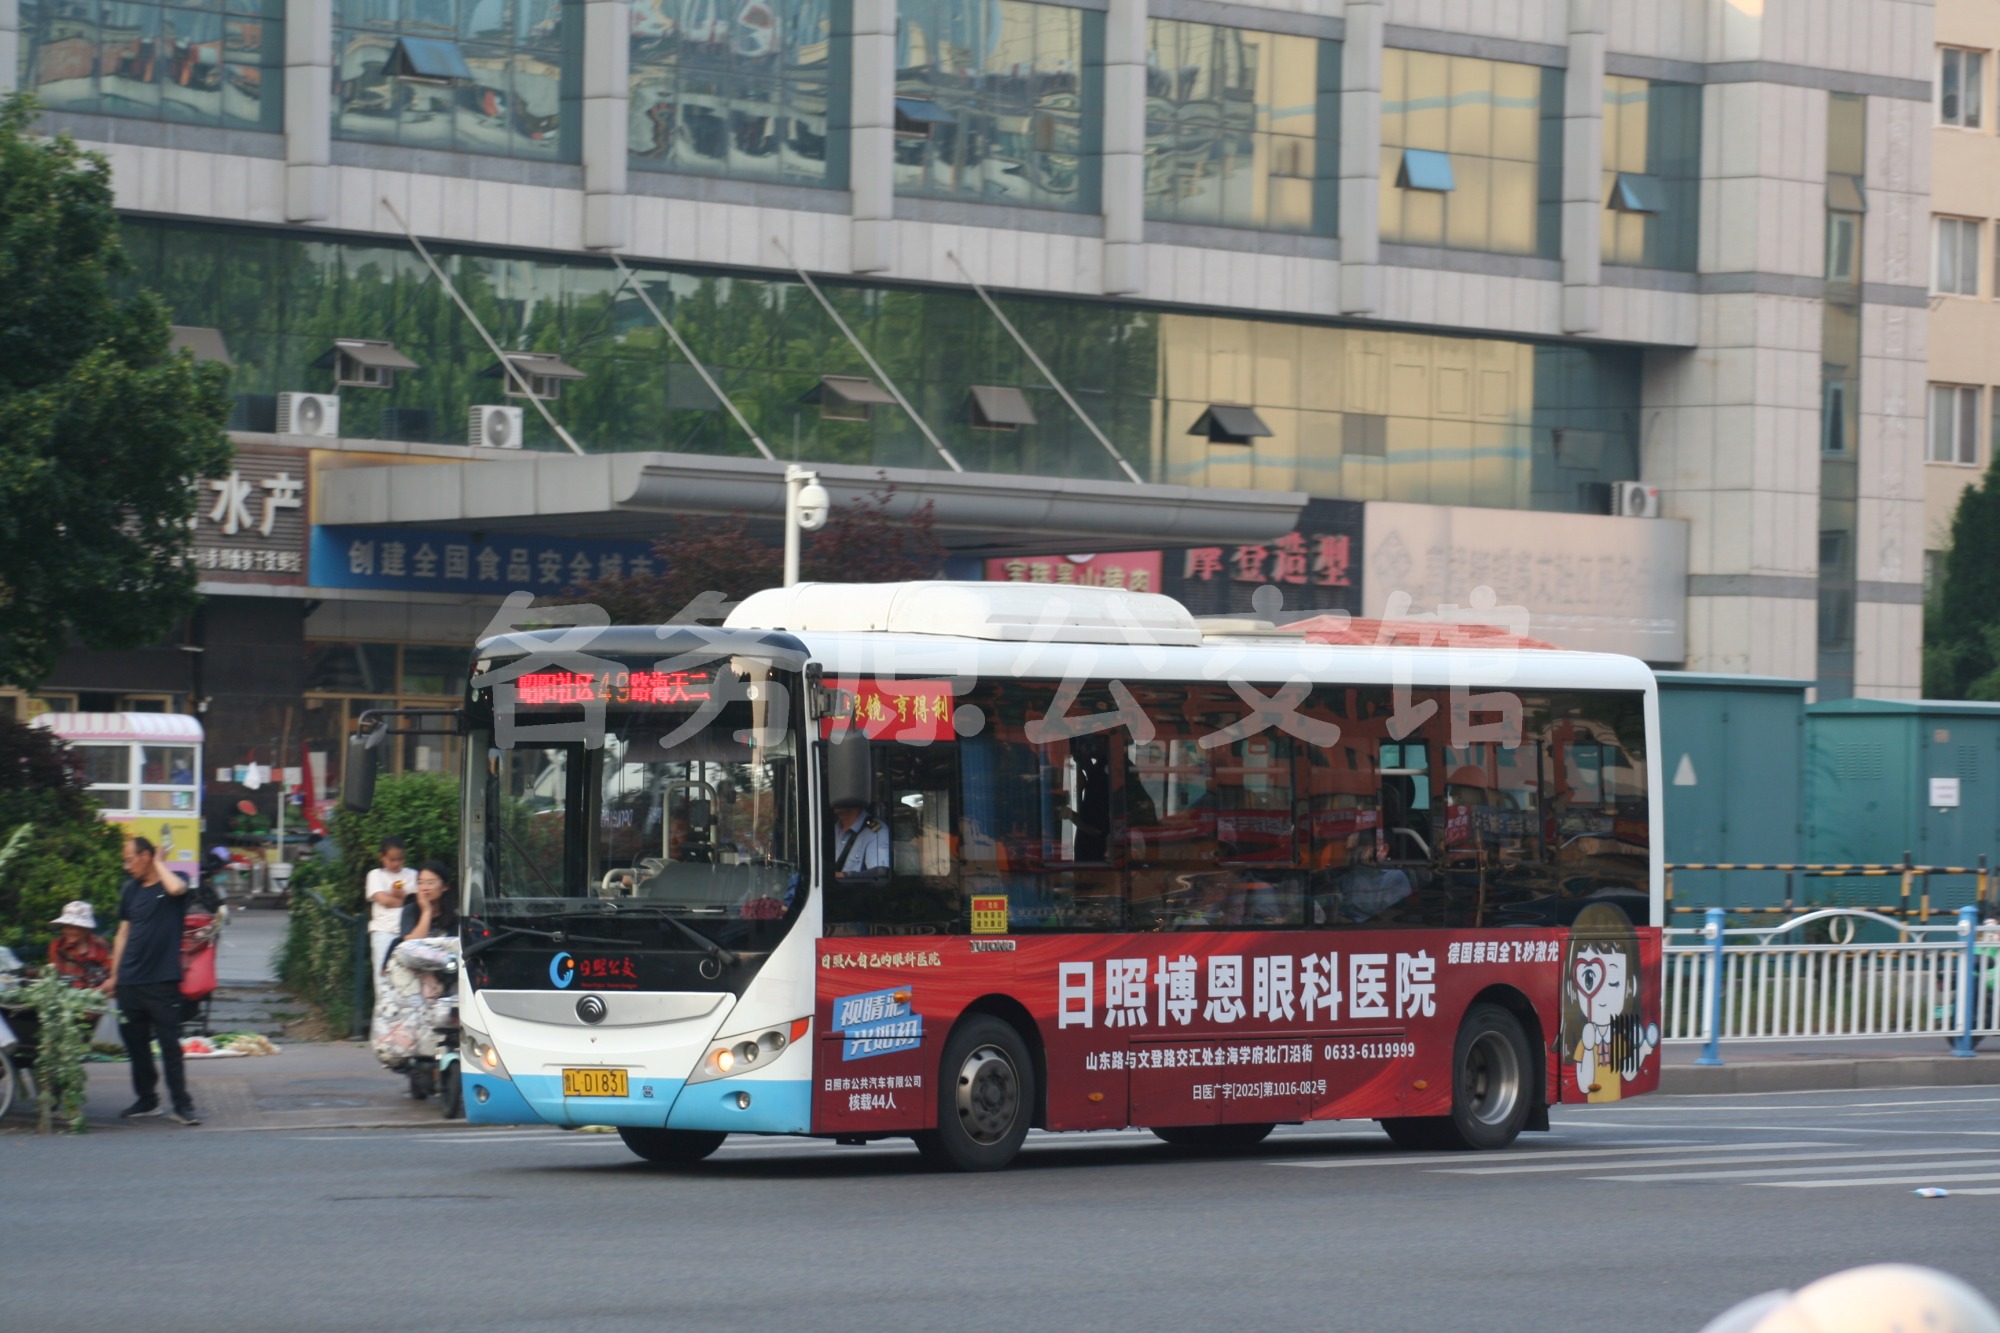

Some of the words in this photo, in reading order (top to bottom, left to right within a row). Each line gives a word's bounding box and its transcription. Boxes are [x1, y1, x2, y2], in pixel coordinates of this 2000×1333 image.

[163, 470, 304, 538] 水产
[892, 694, 950, 723] 亨得利
[970, 940, 1016, 953] YUTONG
[1447, 940, 1560, 965] 德国蔡司全飞秒激光
[821, 951, 942, 969] 日照人自己的眼科医院
[1058, 949, 1437, 1030] 日照博恩眼科医院
[850, 1019, 919, 1056] 光如初
[1085, 1044, 1313, 1071] 山东路与文登路交汇处金海学府北门沿街
[1324, 1042, 1416, 1061] 0633-6119999
[824, 1075, 922, 1092] 日照市公共汽车有限公司
[1192, 1079, 1328, 1100] 日医广字[2025]第1016-082号
[848, 1091, 897, 1112] 核载44人
